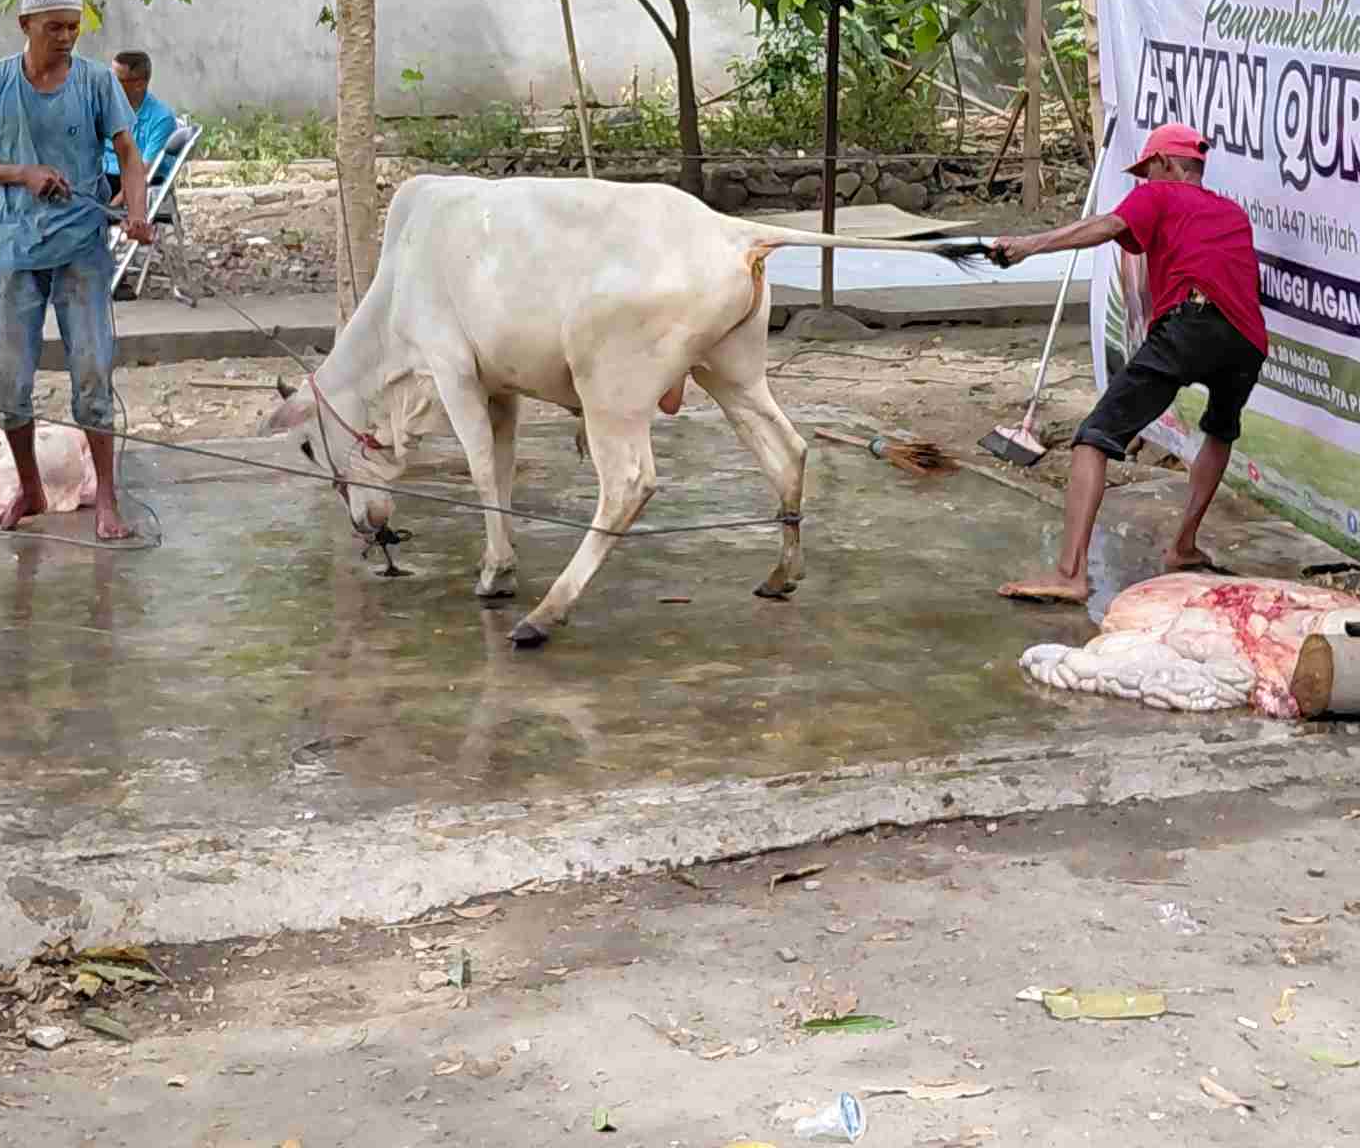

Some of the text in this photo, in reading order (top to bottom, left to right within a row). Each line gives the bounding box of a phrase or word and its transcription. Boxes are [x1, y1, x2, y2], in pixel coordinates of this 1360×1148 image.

[1276, 204, 1306, 239] 1447
[1310, 213, 1358, 254] Hijriah
[1297, 374, 1331, 401] DINAS
[1331, 384, 1349, 411] PTA
